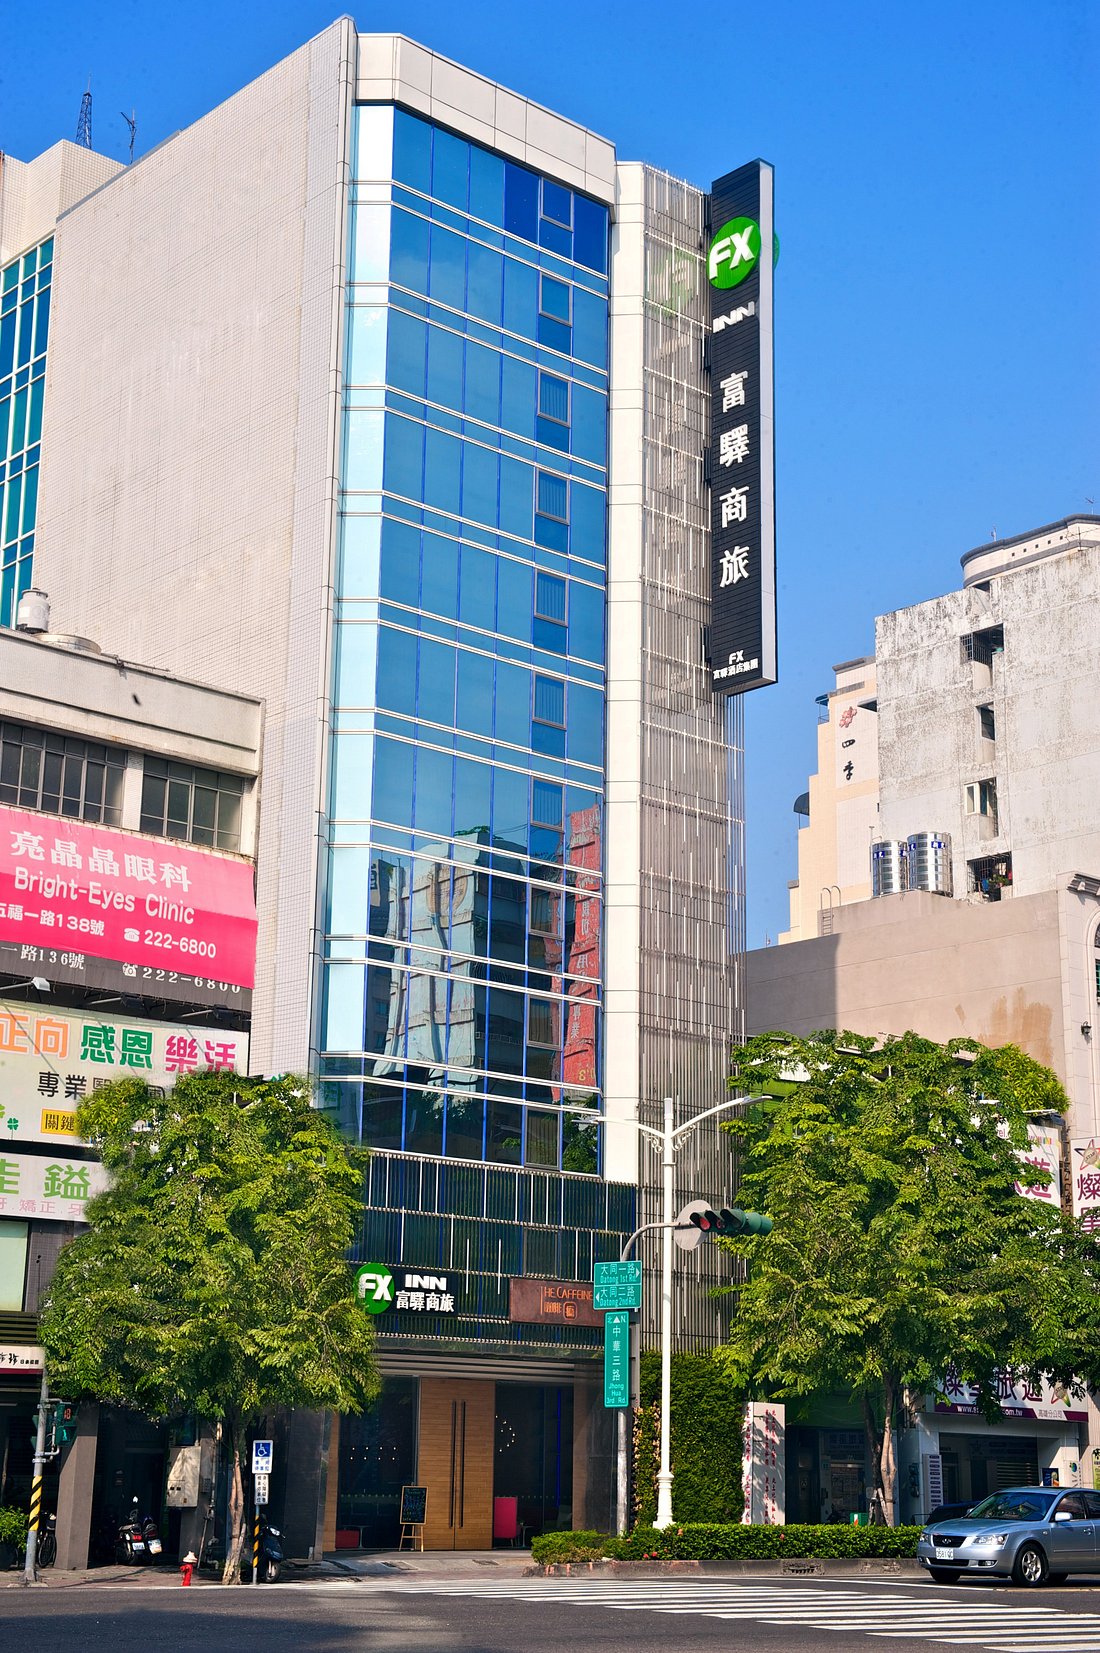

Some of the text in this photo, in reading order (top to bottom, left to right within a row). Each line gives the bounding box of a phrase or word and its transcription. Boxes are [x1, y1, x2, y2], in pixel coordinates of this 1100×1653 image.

[709, 225, 755, 280] FX
[713, 301, 755, 333] INN
[719, 370, 750, 588] 富驛商旅
[728, 649, 745, 665] FX
[10, 831, 193, 892] 亮晶晶眼科
[14, 866, 195, 925] Bright-Eyes Clinic
[144, 930, 217, 959] 222-6800
[80, 1024, 153, 1069] 感恩
[600, 1263, 635, 1275] 大同一路
[358, 1272, 447, 1301] FX INN
[395, 1290, 455, 1312] 富驛商旅
[556, 1286, 593, 1301] CAFFEINE
[600, 1286, 635, 1298] 大同二路
[612, 1325, 621, 1381] 中華三路
